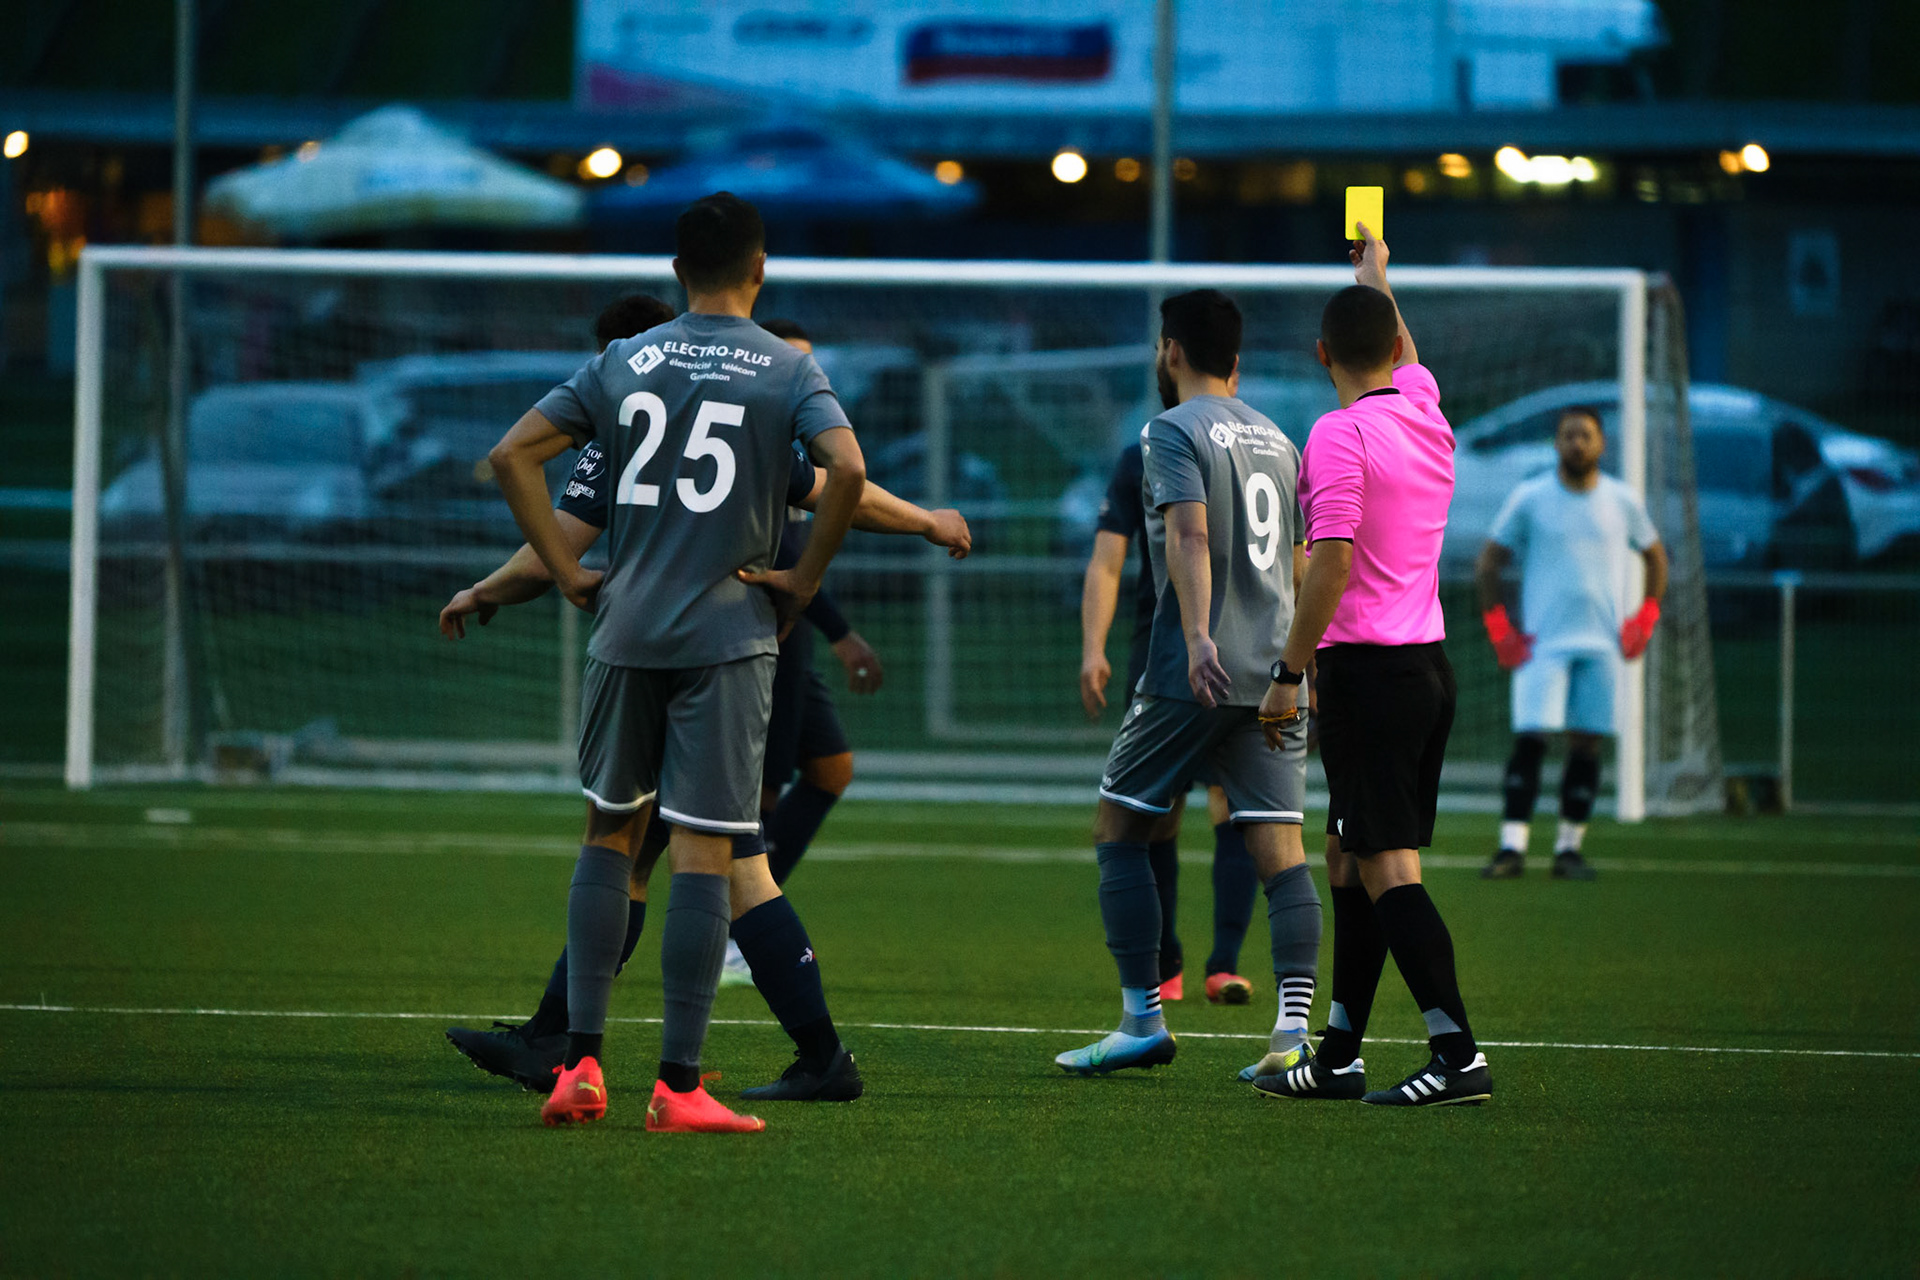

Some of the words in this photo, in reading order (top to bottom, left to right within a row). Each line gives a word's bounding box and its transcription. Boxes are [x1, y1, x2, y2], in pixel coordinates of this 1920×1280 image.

[662, 340, 772, 367] ELECTRO-PLUS
[721, 361, 757, 377] télécom
[616, 391, 746, 513] 25
[576, 457, 597, 475] Chef
[1245, 472, 1280, 571] 9
